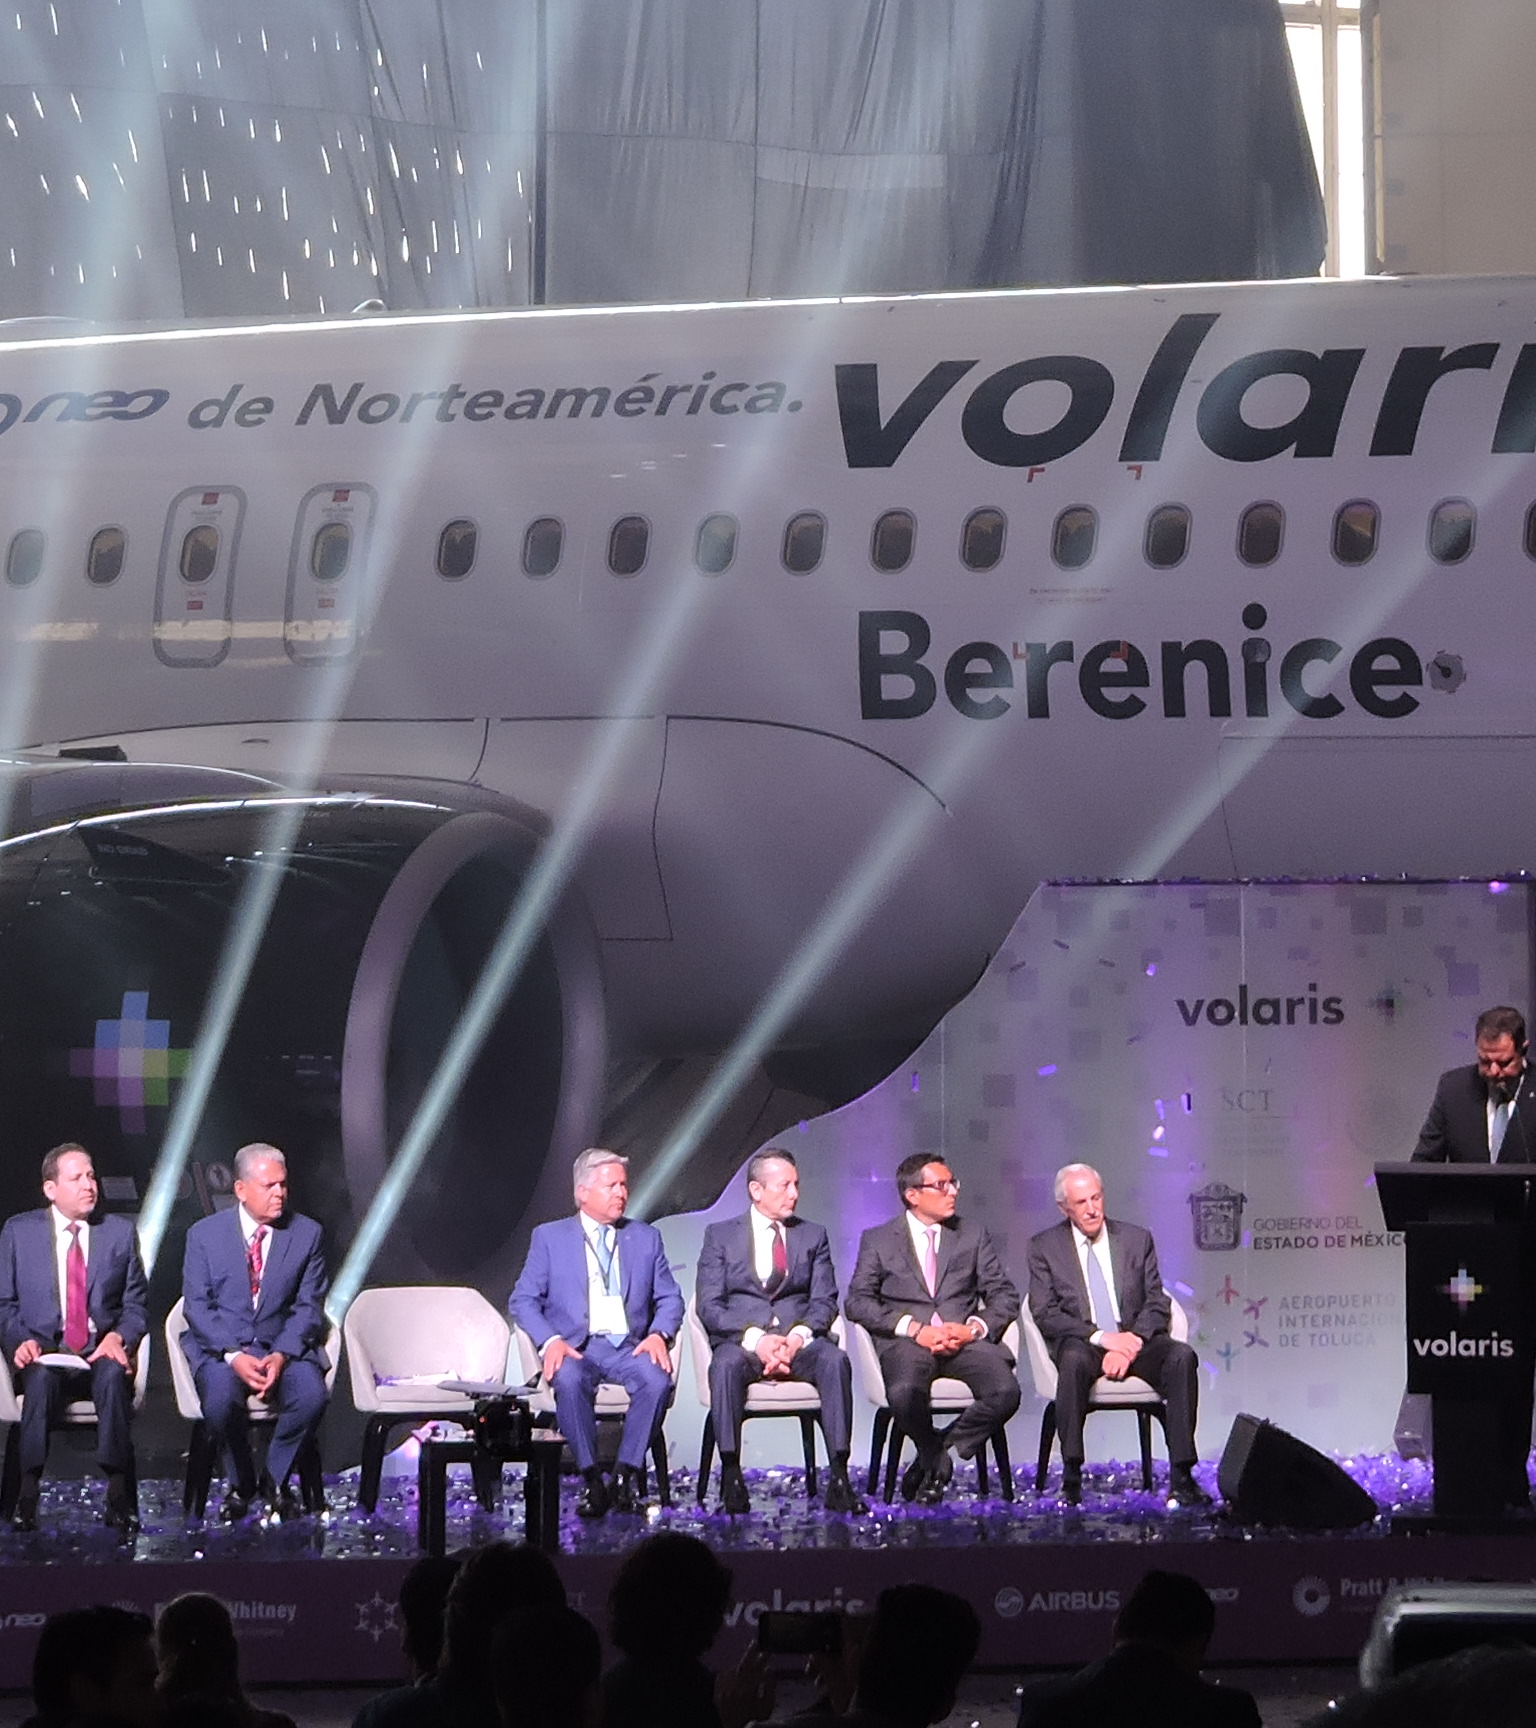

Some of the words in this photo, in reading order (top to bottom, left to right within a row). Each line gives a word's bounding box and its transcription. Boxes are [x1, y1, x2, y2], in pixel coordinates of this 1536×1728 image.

[186, 383, 276, 430] de
[294, 370, 804, 427] Norteamérica.
[858, 603, 1424, 721] Berenice
[1175, 983, 1346, 1027] volaris
[1219, 1086, 1274, 1113] SCT
[1253, 1216, 1331, 1232] GOBIERNO
[1335, 1215, 1363, 1230] DEL
[1253, 1235, 1320, 1251] ESTADO
[1324, 1234, 1346, 1248] DE
[1350, 1230, 1406, 1248] MÉXIC
[1278, 1294, 1396, 1311] AEROPUERTO
[1279, 1332, 1300, 1348] DE
[1309, 1332, 1378, 1348] TOLUCA
[1412, 1330, 1515, 1358] volaris
[1027, 1589, 1122, 1612] AIRBUS
